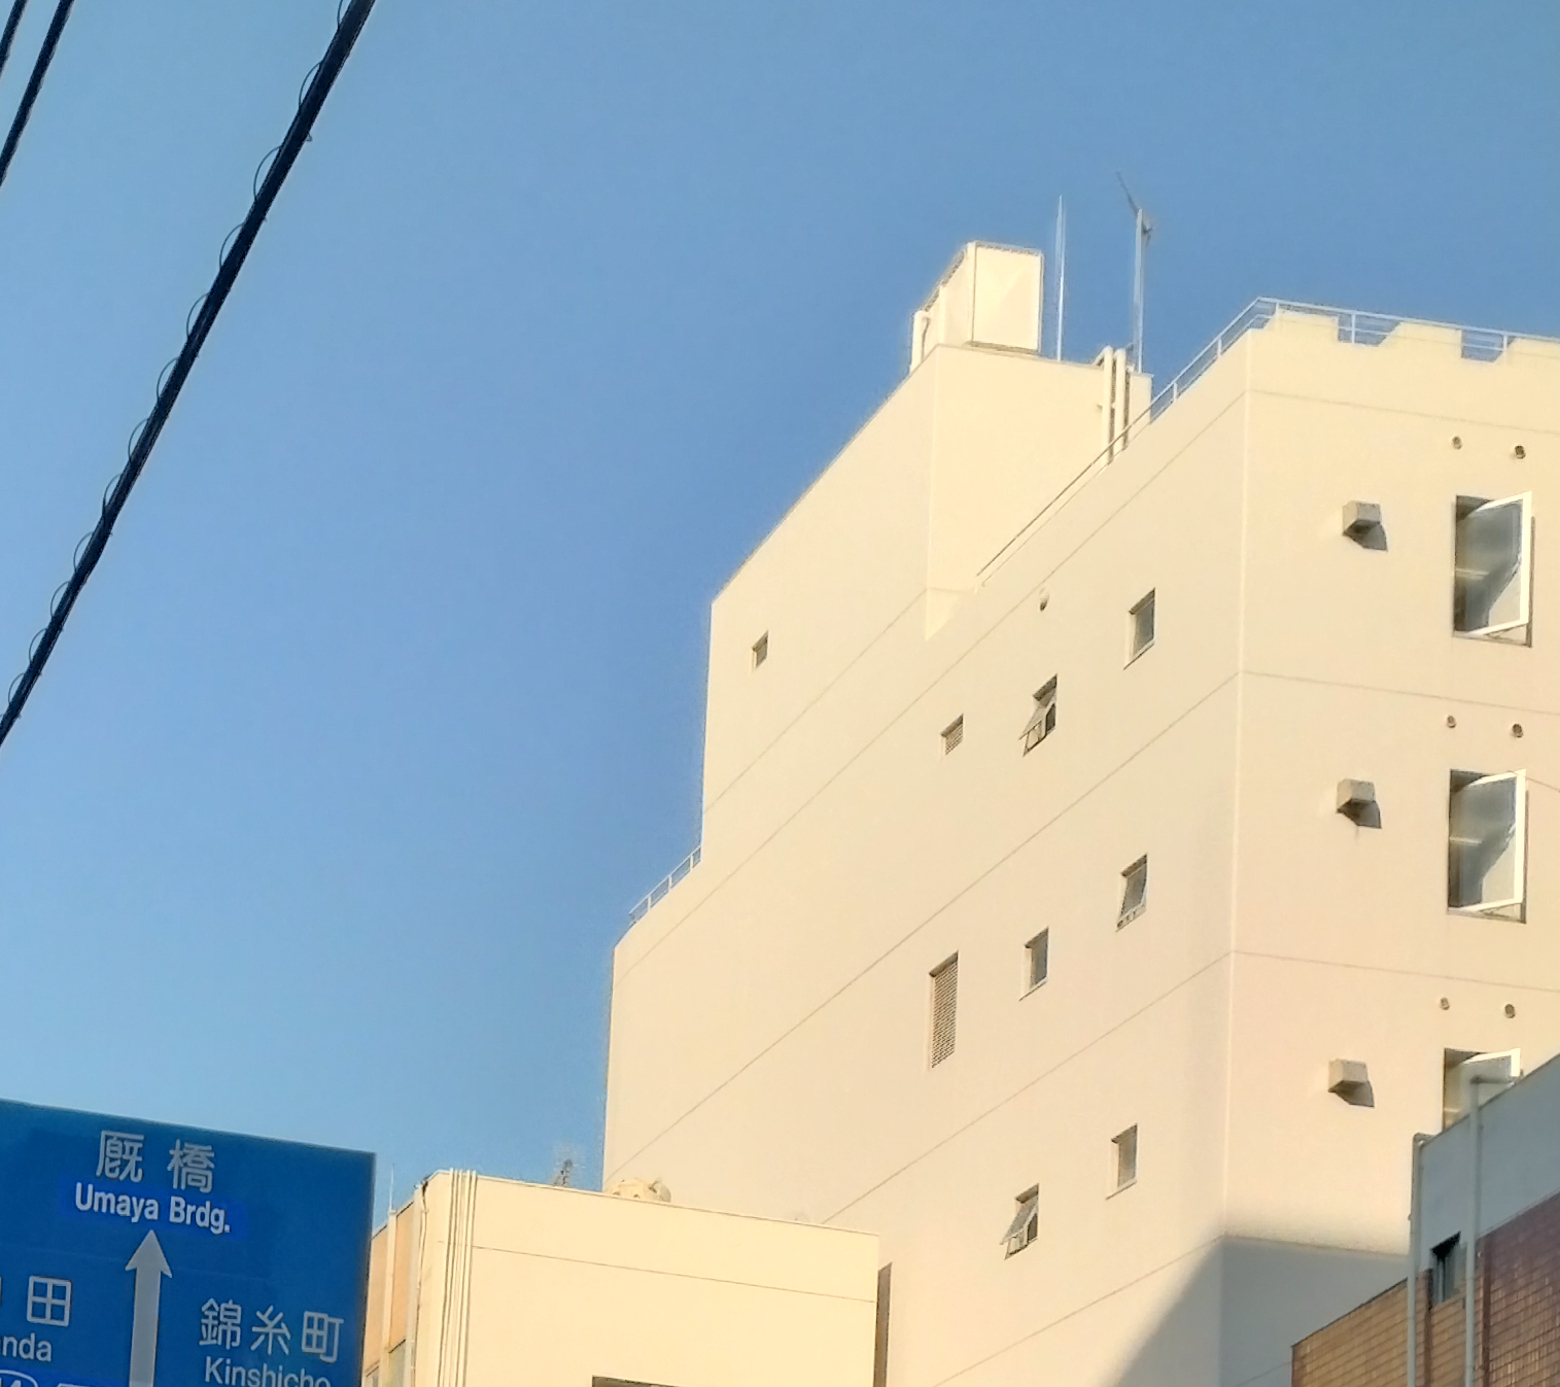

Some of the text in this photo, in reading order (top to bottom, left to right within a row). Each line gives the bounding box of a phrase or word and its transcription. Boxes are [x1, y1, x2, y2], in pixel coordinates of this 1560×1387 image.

[75, 1182, 231, 1235] Umaya Brdg.
[199, 1298, 345, 1364] 錦糸町
